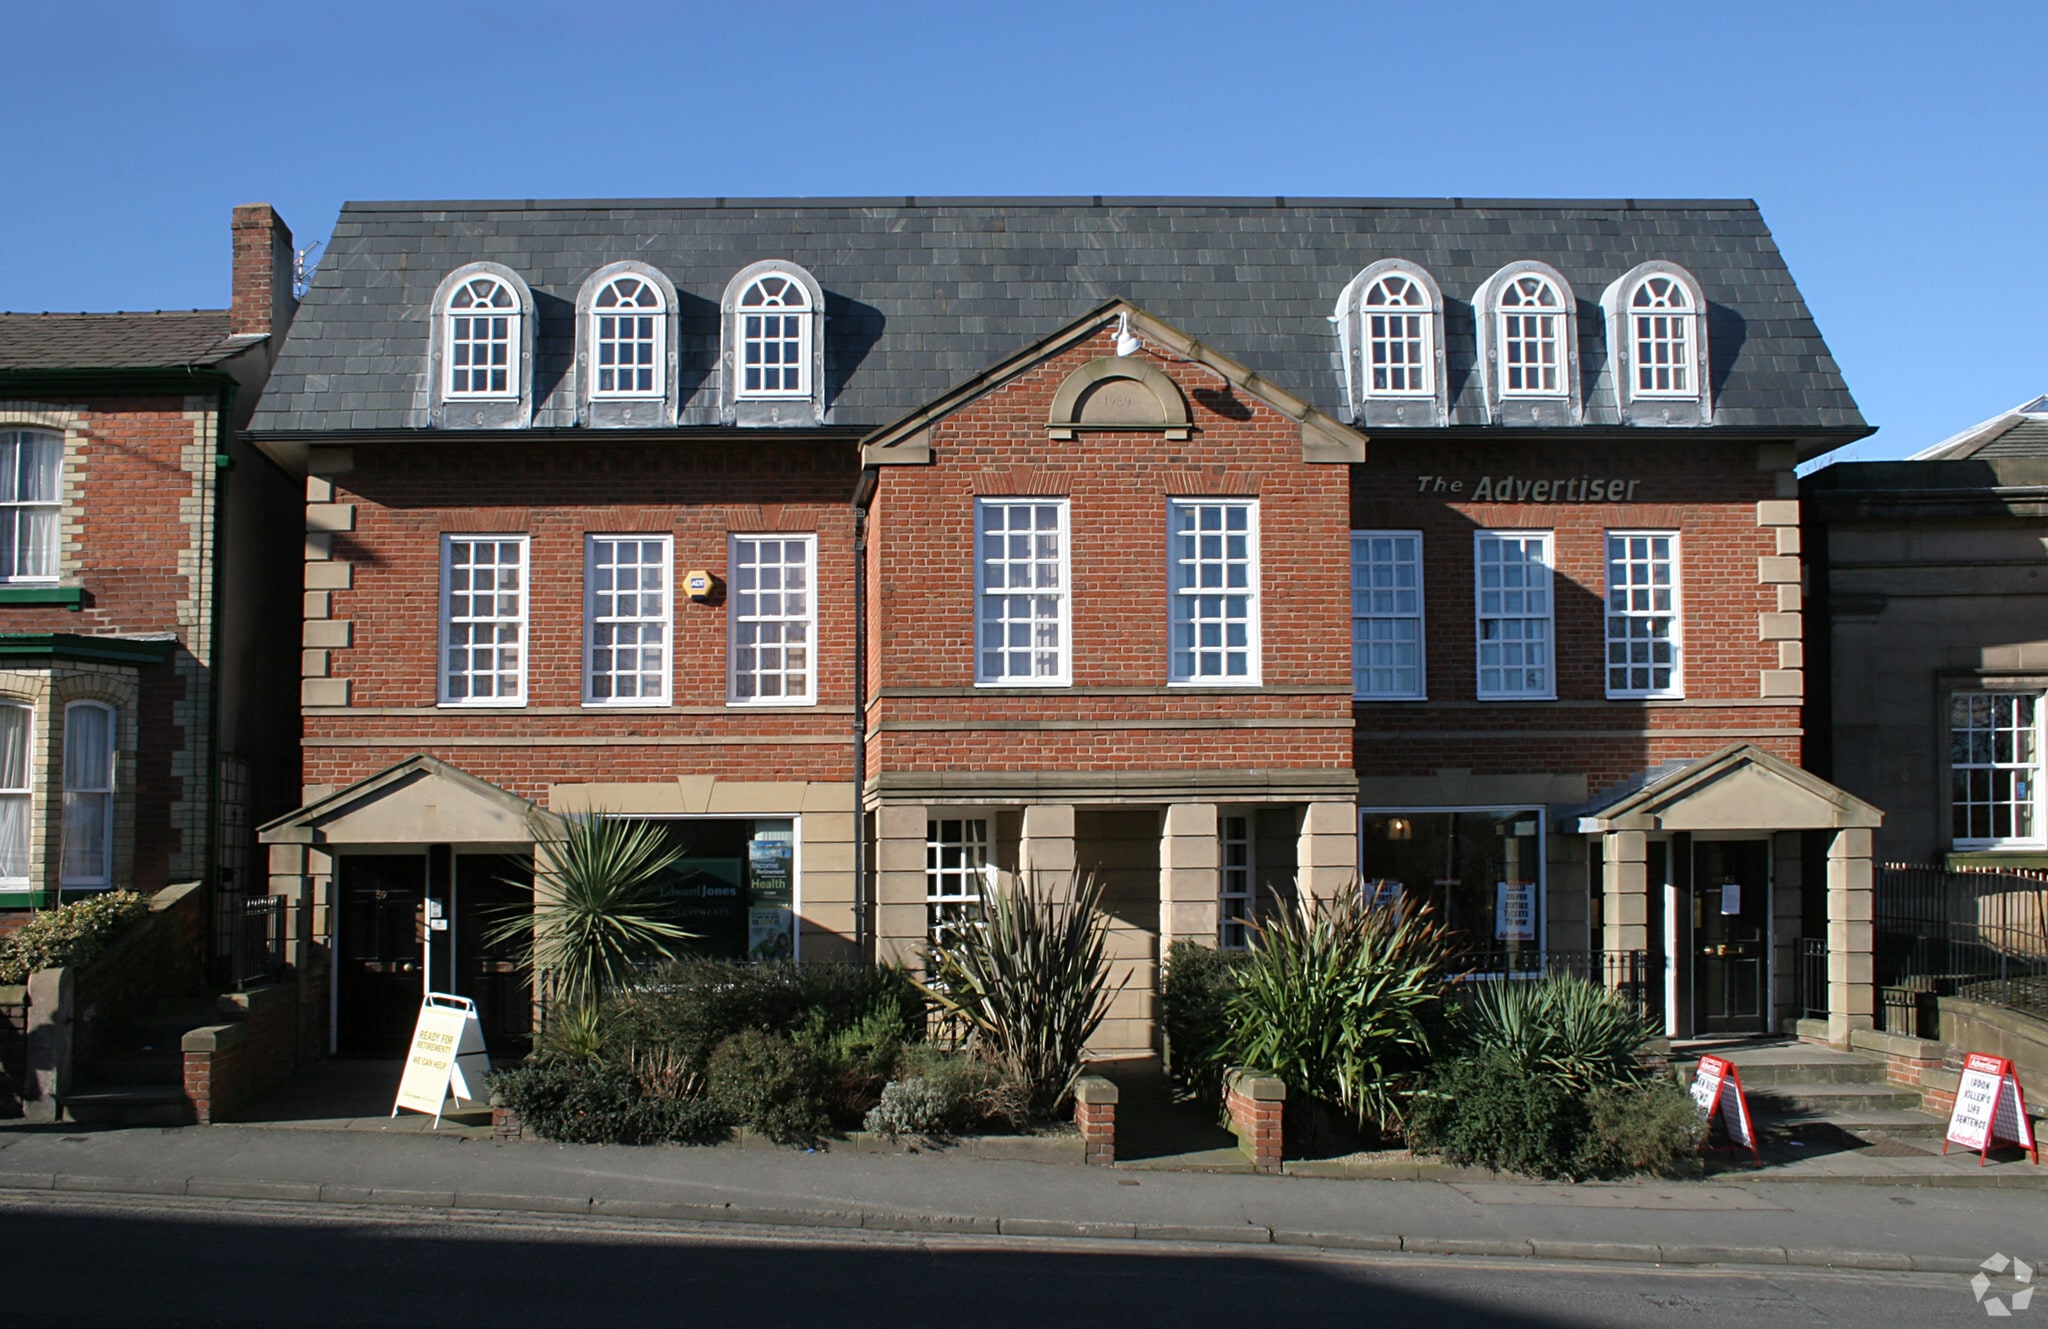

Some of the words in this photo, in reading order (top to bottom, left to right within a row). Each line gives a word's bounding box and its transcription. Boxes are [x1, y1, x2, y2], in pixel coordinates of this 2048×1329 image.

[1104, 394, 1132, 408] 1989
[1417, 475, 1463, 493] The
[1471, 474, 1641, 502] Advertiser
[751, 861, 779, 869] Income
[751, 878, 786, 889] Health
[419, 1030, 440, 1042] READY
[441, 1033, 454, 1045] FOR
[413, 1056, 422, 1064] WE
[422, 1058, 433, 1067] CAN
[1964, 1090, 1991, 1104] KILLER'S
[1967, 1104, 1981, 1115] LIFE
[1956, 1114, 1987, 1130] SENTENCE
